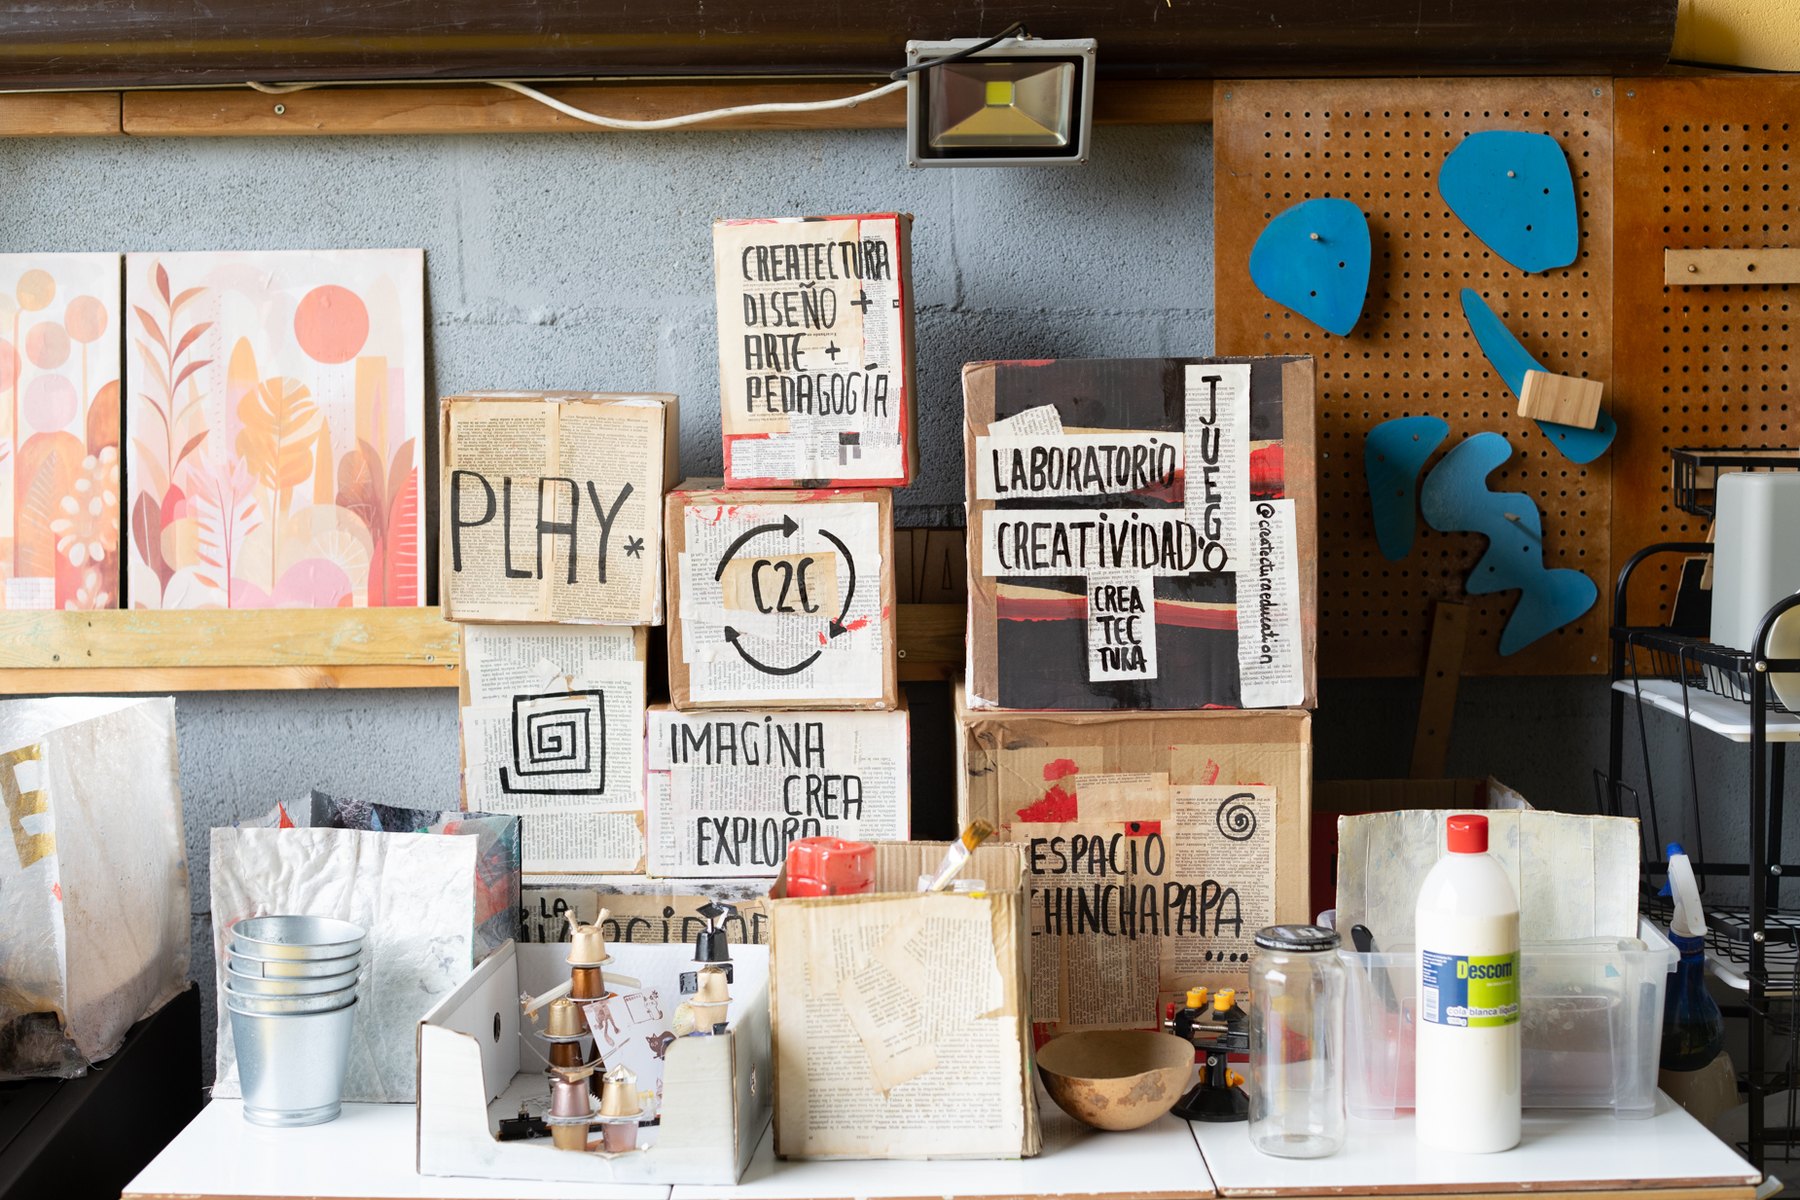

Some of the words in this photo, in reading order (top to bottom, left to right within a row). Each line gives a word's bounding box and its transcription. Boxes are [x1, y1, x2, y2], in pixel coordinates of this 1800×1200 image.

[741, 240, 892, 282] CREATECTURA
[743, 281, 837, 330] DISEÑO
[744, 332, 809, 373] ARTE
[746, 362, 889, 418] PEDAGOGÍA
[992, 438, 1176, 493] LABORATORIO
[1199, 375, 1228, 573] JUEGO
[752, 556, 820, 614] C2C
[1095, 585, 1145, 613] CREA
[1096, 615, 1141, 645] TEC
[1096, 645, 1148, 673] TURA
[670, 715, 825, 769] IMAGINA
[783, 774, 864, 821] CREA
[1030, 822, 1166, 877] ESPACIO
[540, 896, 569, 919] LA
[1457, 960, 1513, 980] Descom
